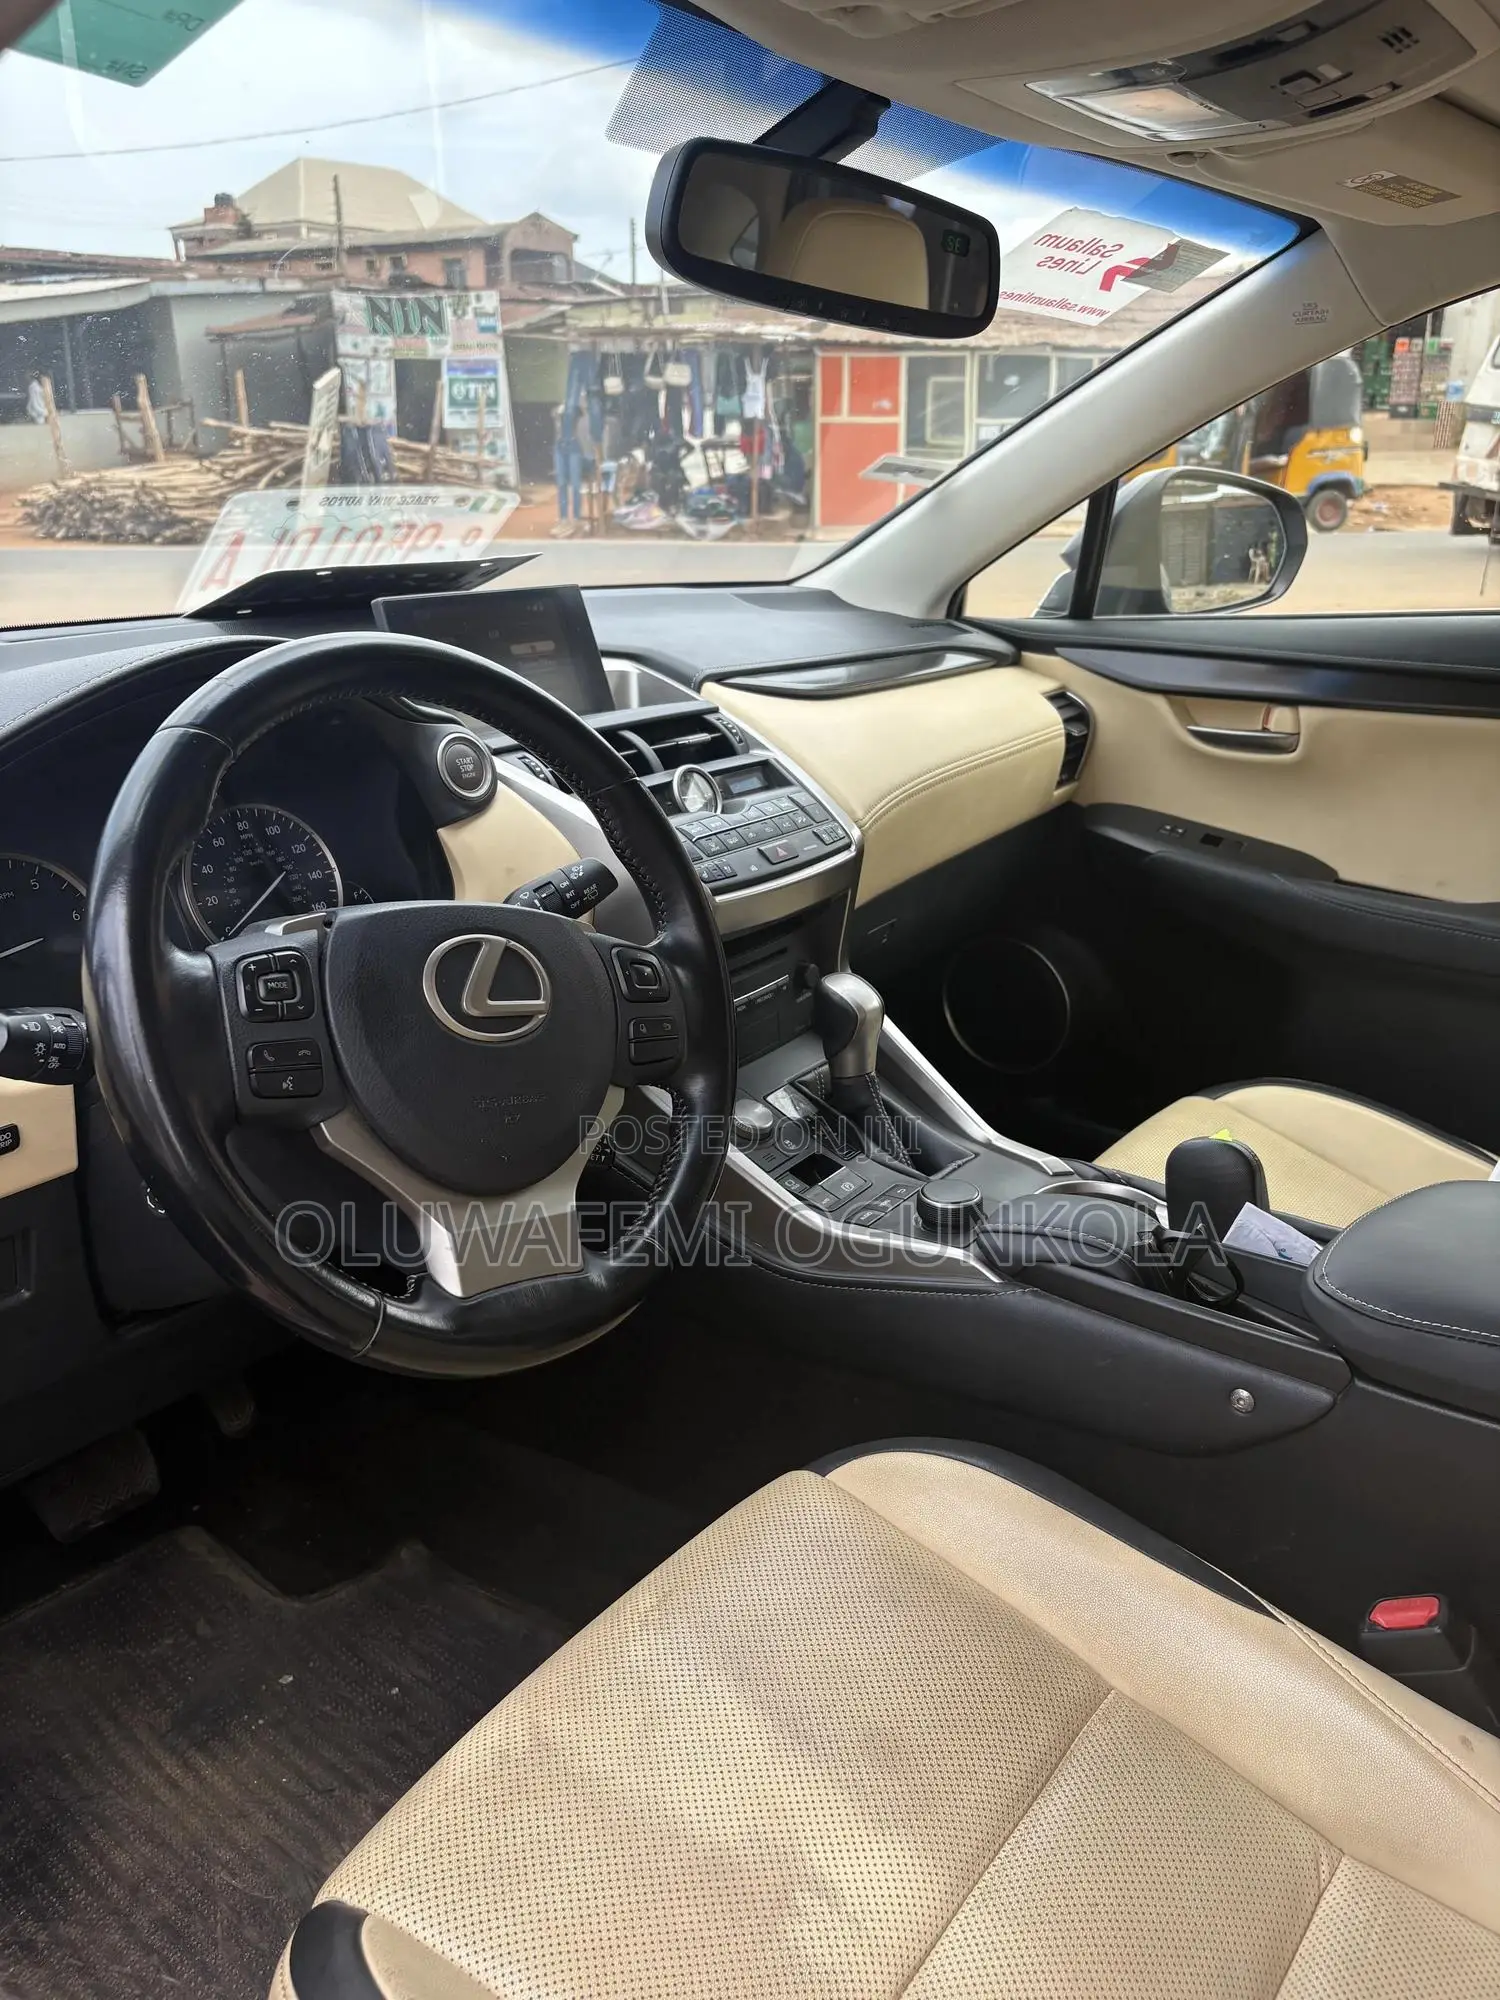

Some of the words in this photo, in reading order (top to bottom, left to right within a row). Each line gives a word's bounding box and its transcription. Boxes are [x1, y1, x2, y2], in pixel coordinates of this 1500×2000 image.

[365, 295, 449, 337] NIN
[456, 757, 474, 766] START
[460, 764, 474, 772] STOP
[237, 820, 249, 831] 80
[265, 825, 281, 836] 100
[212, 837, 225, 847] 60
[291, 844, 306, 854] 120
[201, 864, 214, 874] 40
[308, 871, 323, 881] 140
[30, 880, 40, 890] 5
[583, 883, 598, 895] REAR
[565, 889, 576, 899] INT
[206, 896, 218, 906] 20
[311, 901, 327, 911] 160
[570, 900, 581, 909] OFF
[72, 910, 81, 921] 6
[267, 981, 288, 989] MODE
